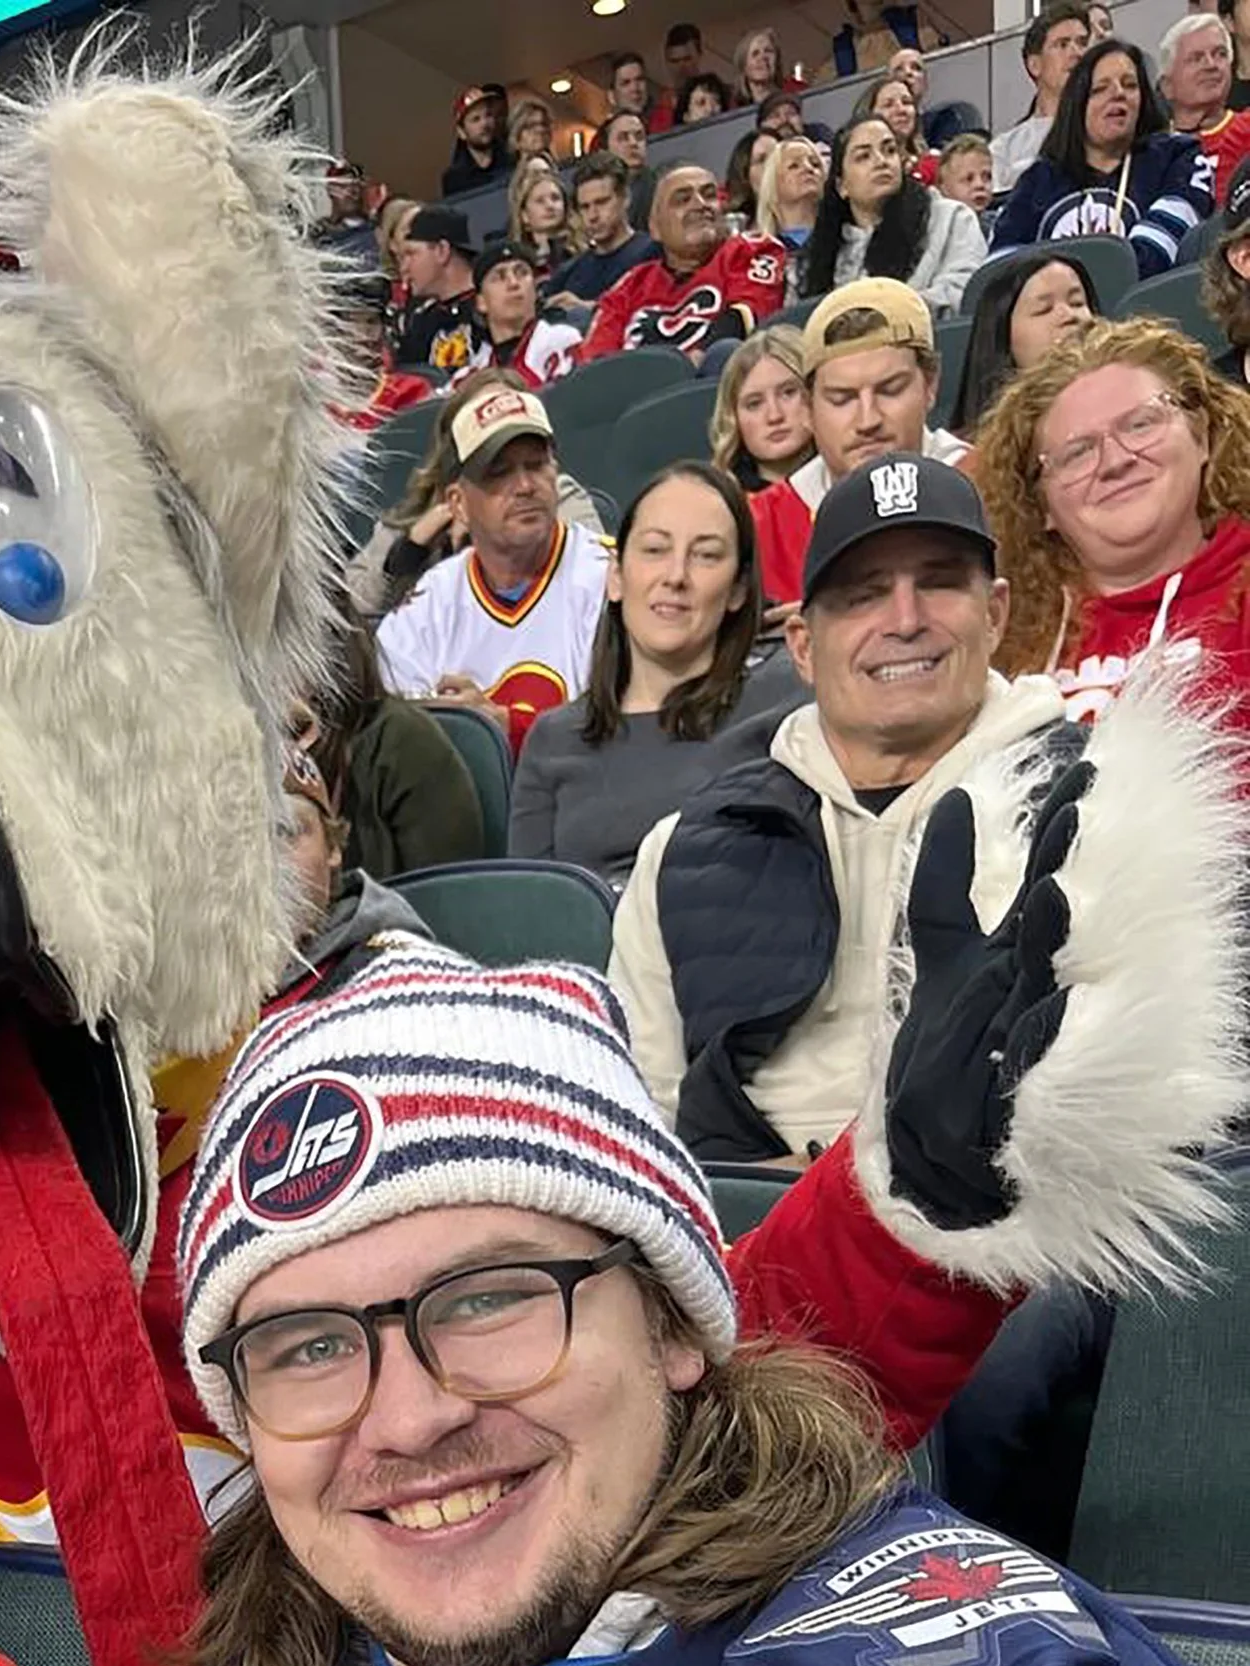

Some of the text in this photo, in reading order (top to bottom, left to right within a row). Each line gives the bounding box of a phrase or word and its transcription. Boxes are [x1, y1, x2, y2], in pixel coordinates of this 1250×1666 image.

[251, 1083, 359, 1201] JETS
[838, 1531, 996, 1584] WINNIPEG
[954, 1596, 1038, 1629] JETS
